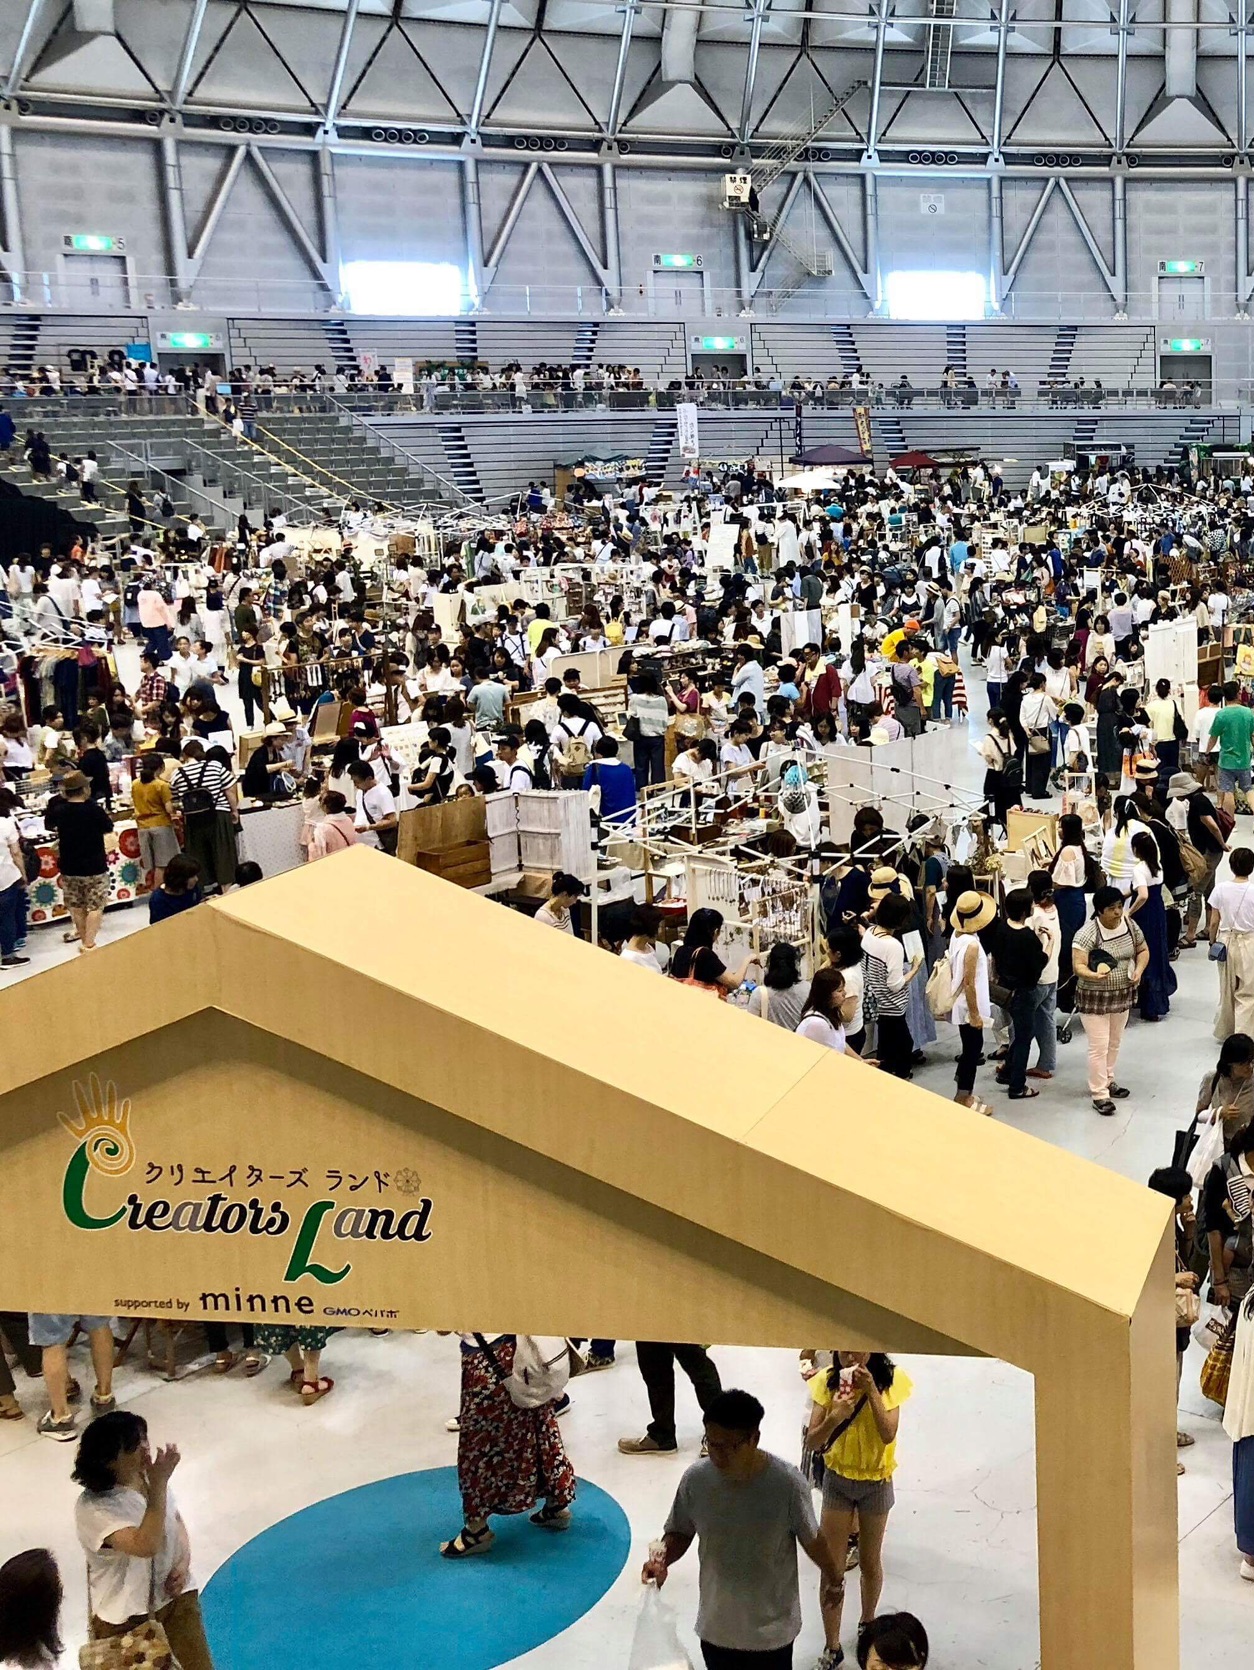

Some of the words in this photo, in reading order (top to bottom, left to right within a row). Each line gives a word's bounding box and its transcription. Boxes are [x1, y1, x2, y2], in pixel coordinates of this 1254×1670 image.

[145, 1162, 309, 1188] クリエイターズ
[325, 1168, 390, 1193] ランド
[62, 1137, 290, 1236] Creators
[282, 1198, 433, 1286] Land
[113, 1298, 173, 1311] supported
[176, 1298, 190, 1313] by
[199, 1286, 315, 1314] minne
